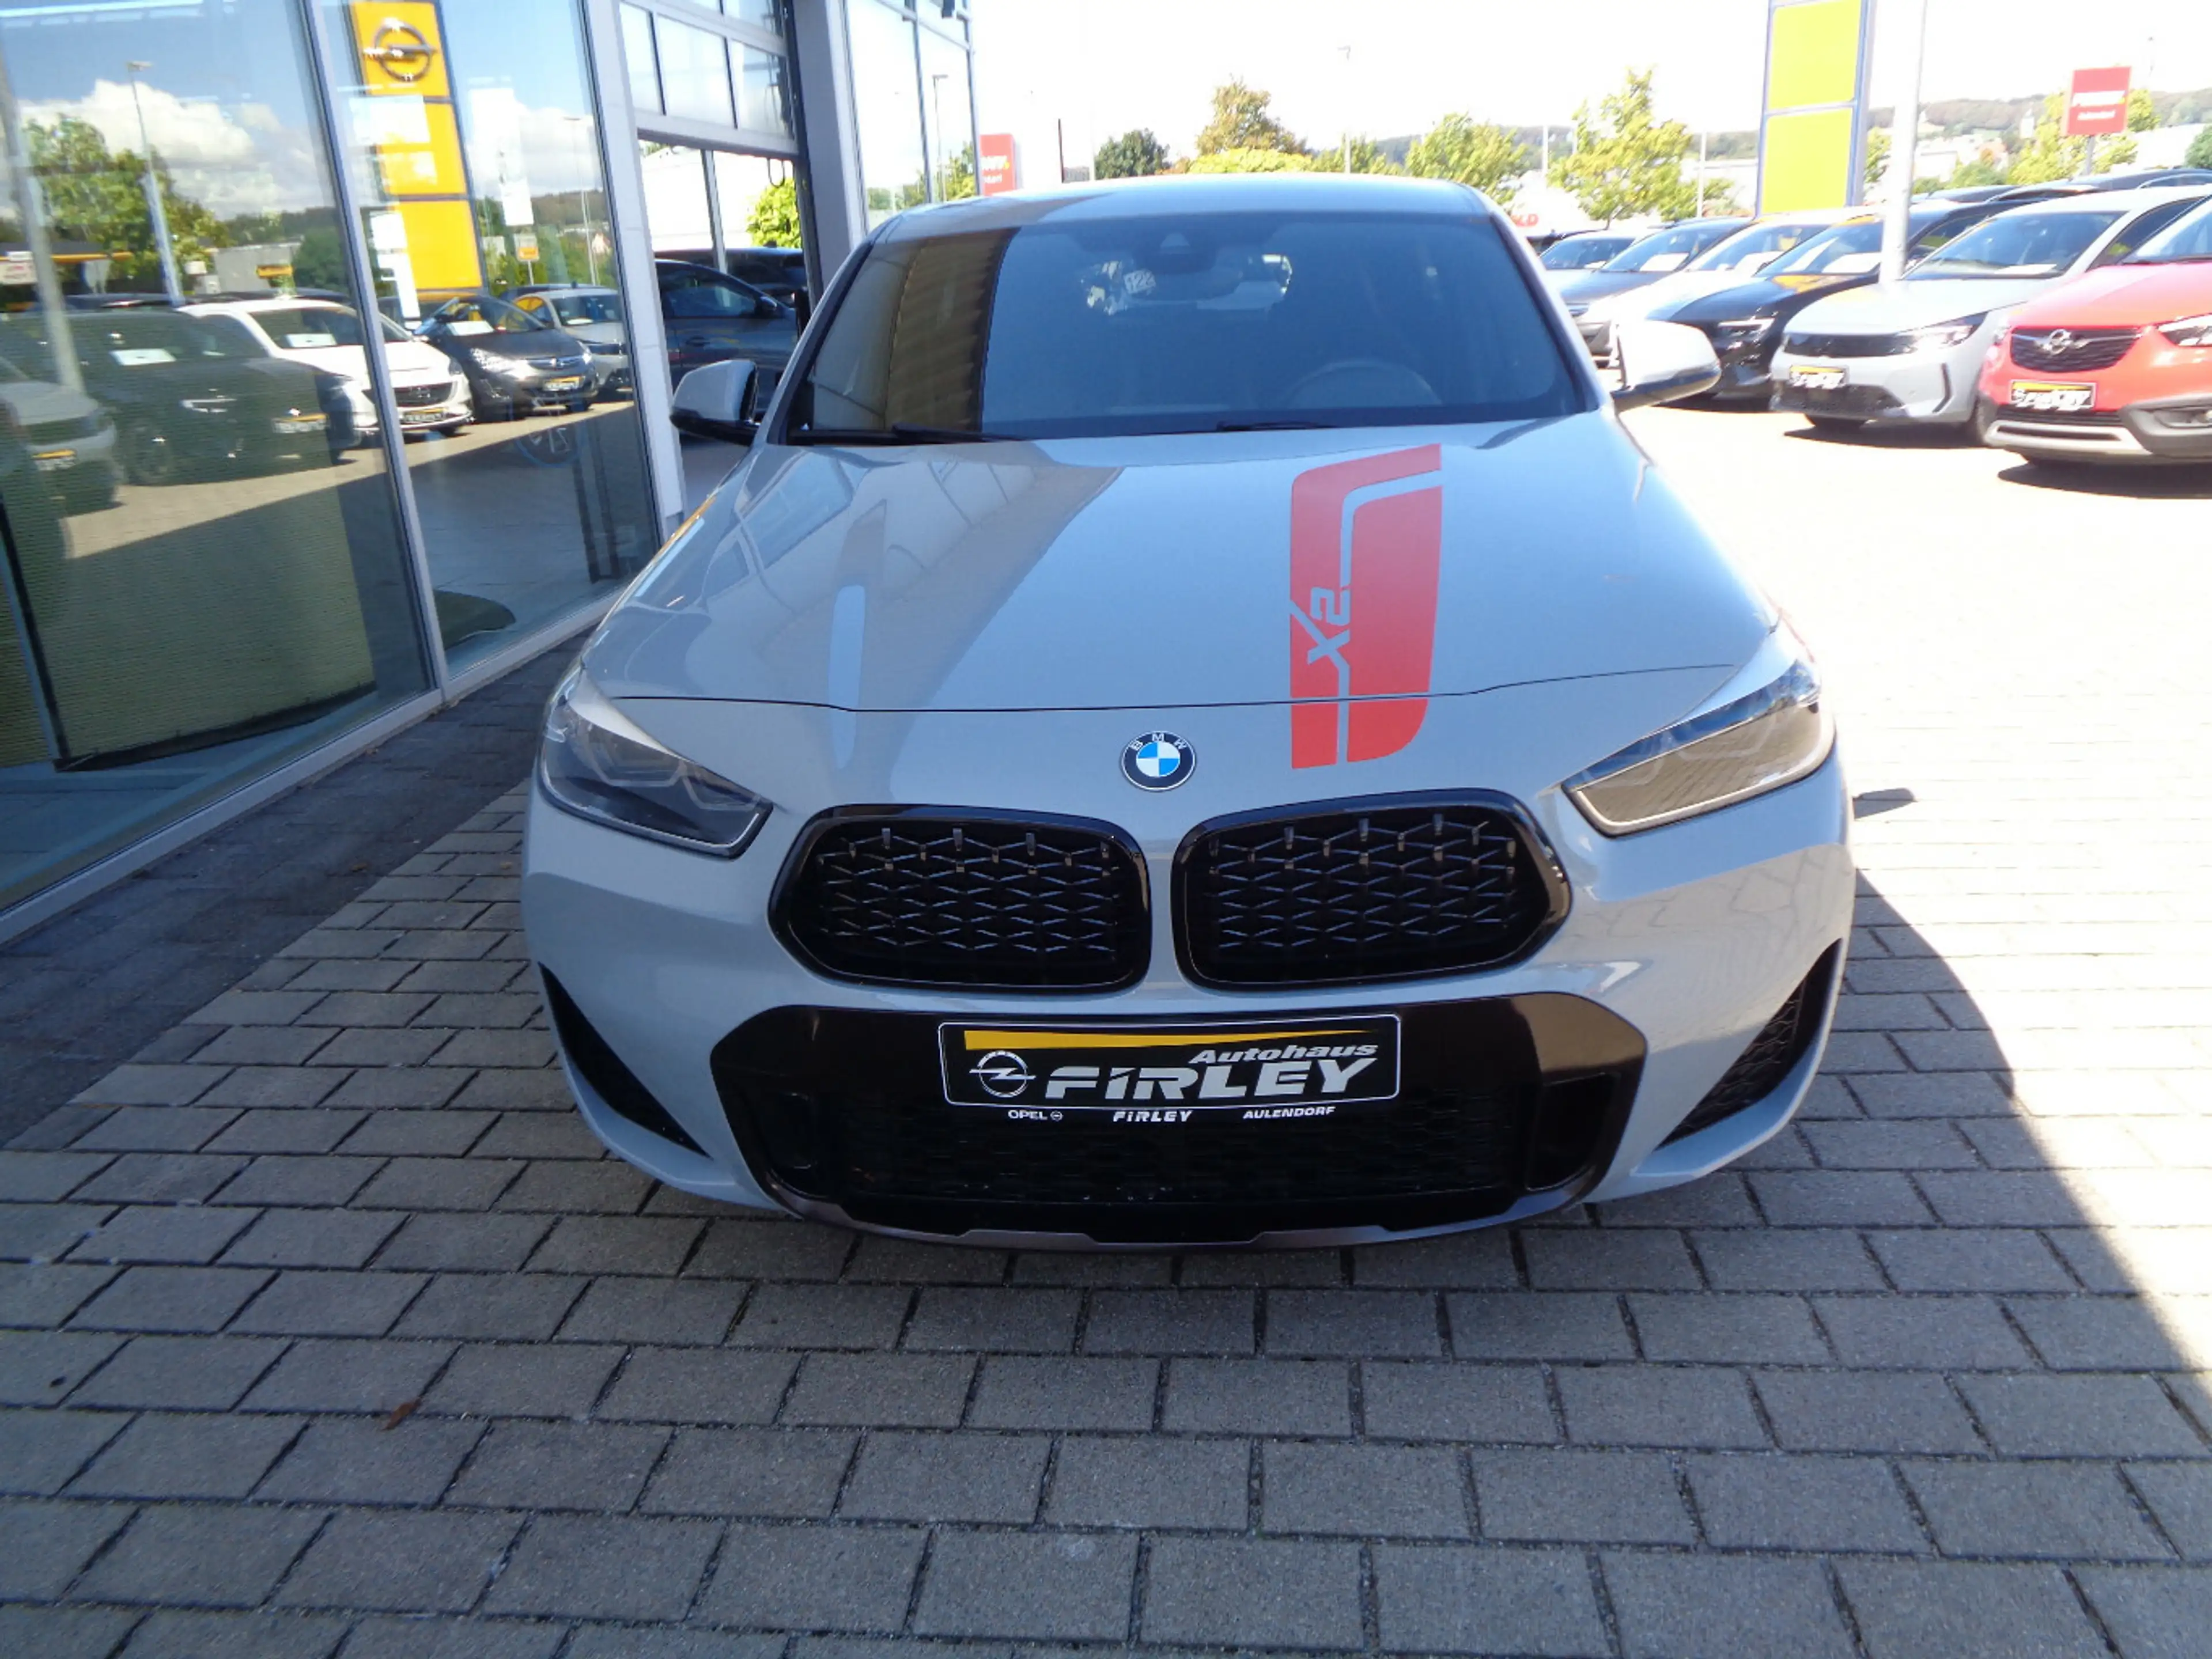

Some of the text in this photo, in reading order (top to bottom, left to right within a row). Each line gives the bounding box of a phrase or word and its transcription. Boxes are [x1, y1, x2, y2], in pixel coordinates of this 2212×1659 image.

[1291, 586, 1351, 668] X2
[1128, 733, 1188, 751] BMW
[1188, 1044, 1378, 1064] Autohaus
[1008, 1109, 1048, 1120] OPEL
[1243, 1106, 1336, 1119] AULENDORF
